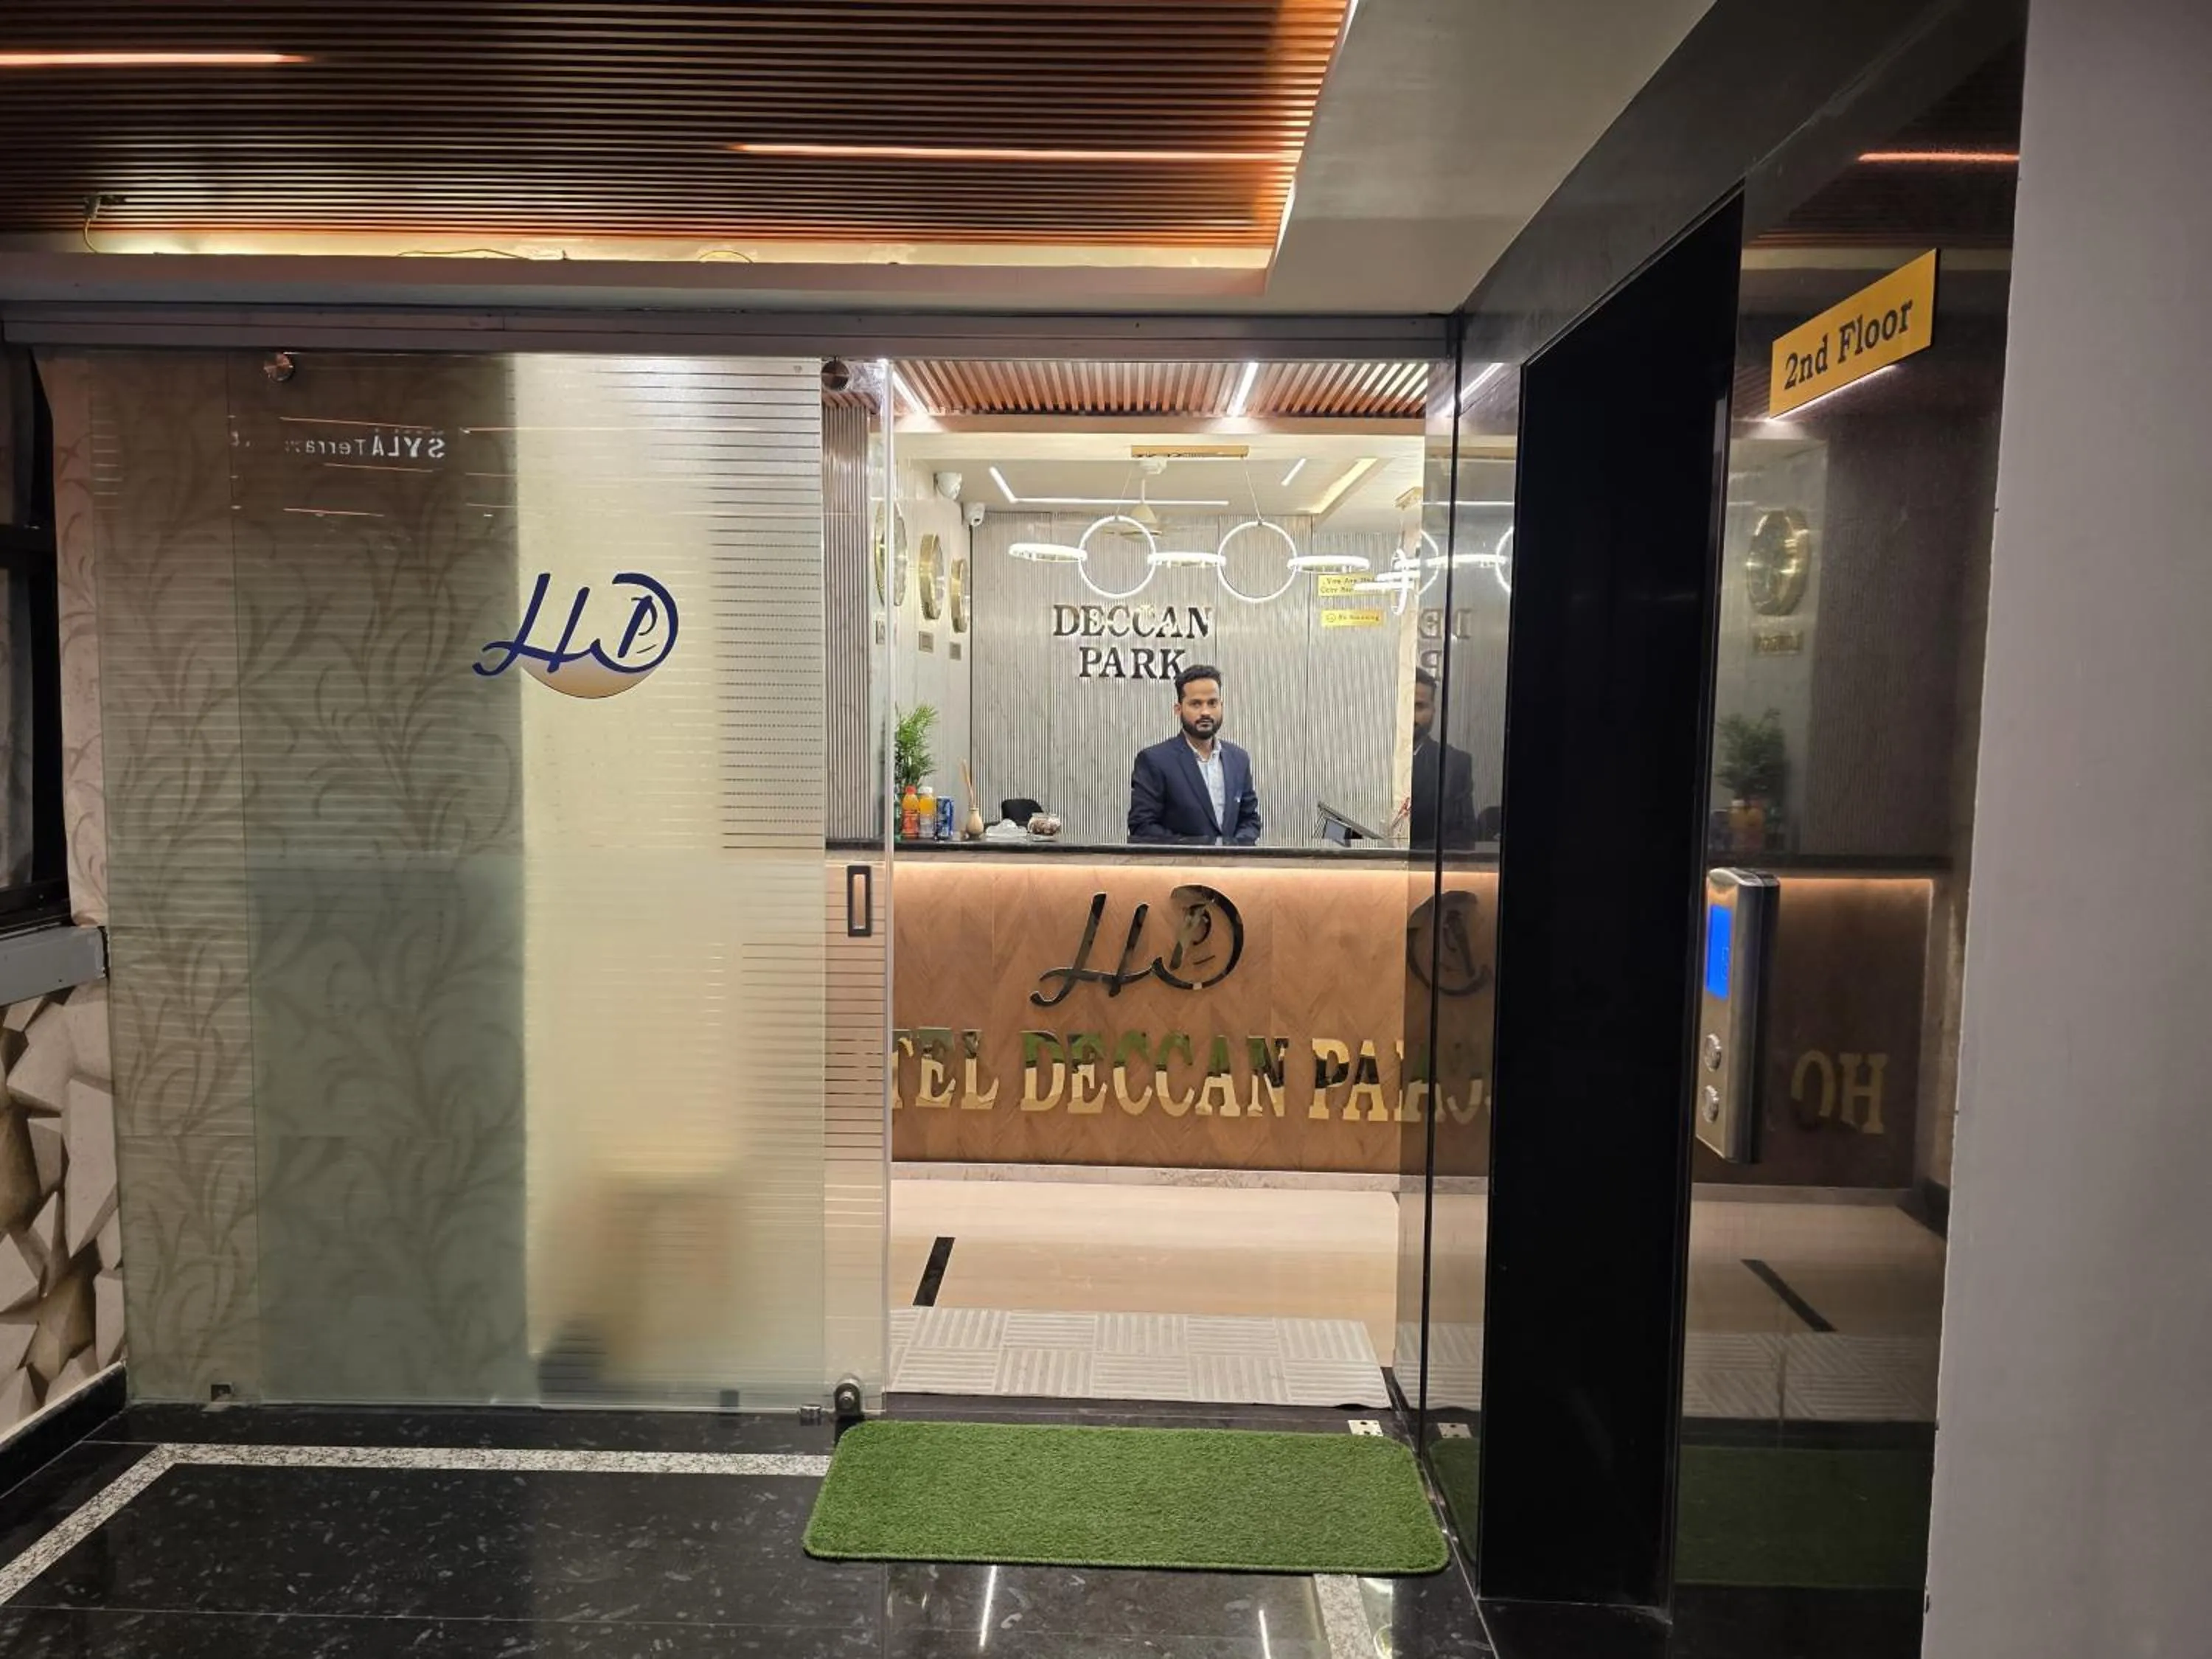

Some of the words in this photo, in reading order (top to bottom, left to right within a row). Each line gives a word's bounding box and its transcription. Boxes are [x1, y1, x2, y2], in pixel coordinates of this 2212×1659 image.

[1783, 332, 1829, 391] 2nd
[1837, 299, 1913, 364] Floor
[1052, 604, 1214, 639] DECCAN
[1078, 646, 1186, 680] PARK
[1020, 1029, 1290, 1118] DECCAN
